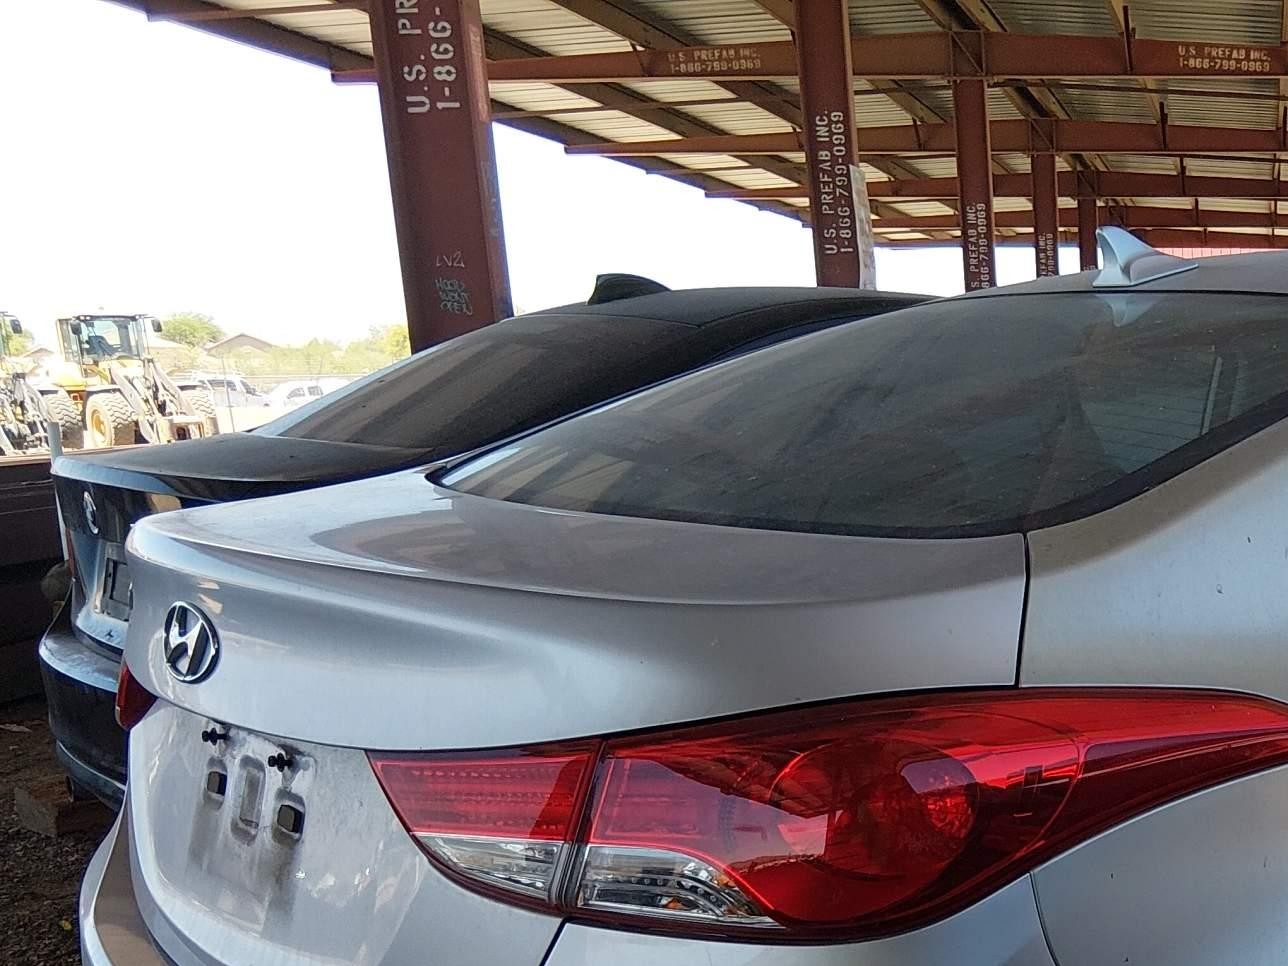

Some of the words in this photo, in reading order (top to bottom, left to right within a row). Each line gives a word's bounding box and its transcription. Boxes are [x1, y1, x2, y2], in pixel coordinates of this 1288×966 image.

[403, 54, 430, 113] U.S.
[815, 110, 831, 141] INC.
[818, 150, 835, 214] PREFAB
[831, 111, 854, 253] 1-866-799-0969
[824, 223, 838, 254] U.S.
